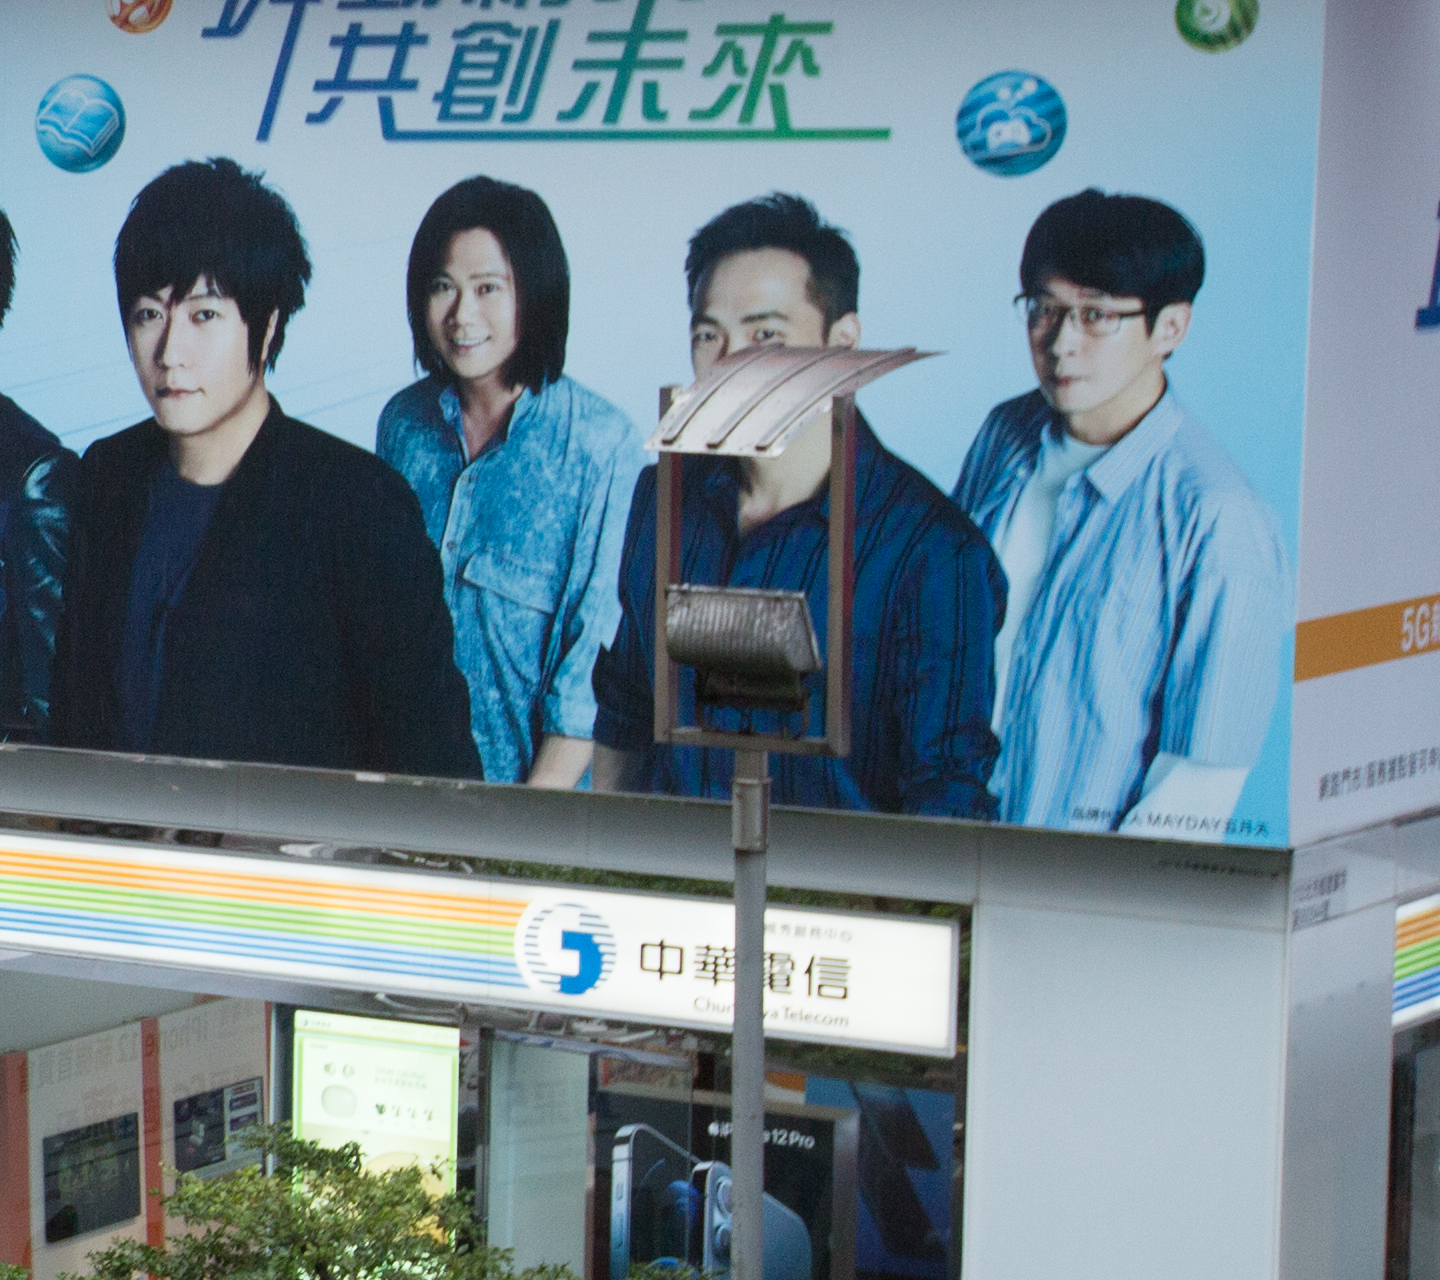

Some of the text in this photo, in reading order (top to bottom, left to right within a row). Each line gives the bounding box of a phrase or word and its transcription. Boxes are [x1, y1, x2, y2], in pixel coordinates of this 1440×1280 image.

[304, 14, 860, 141] 共創未來
[640, 939, 852, 1001] 中華電信
[783, 1006, 849, 1028] Telecom
[792, 1128, 815, 1150] Pro
